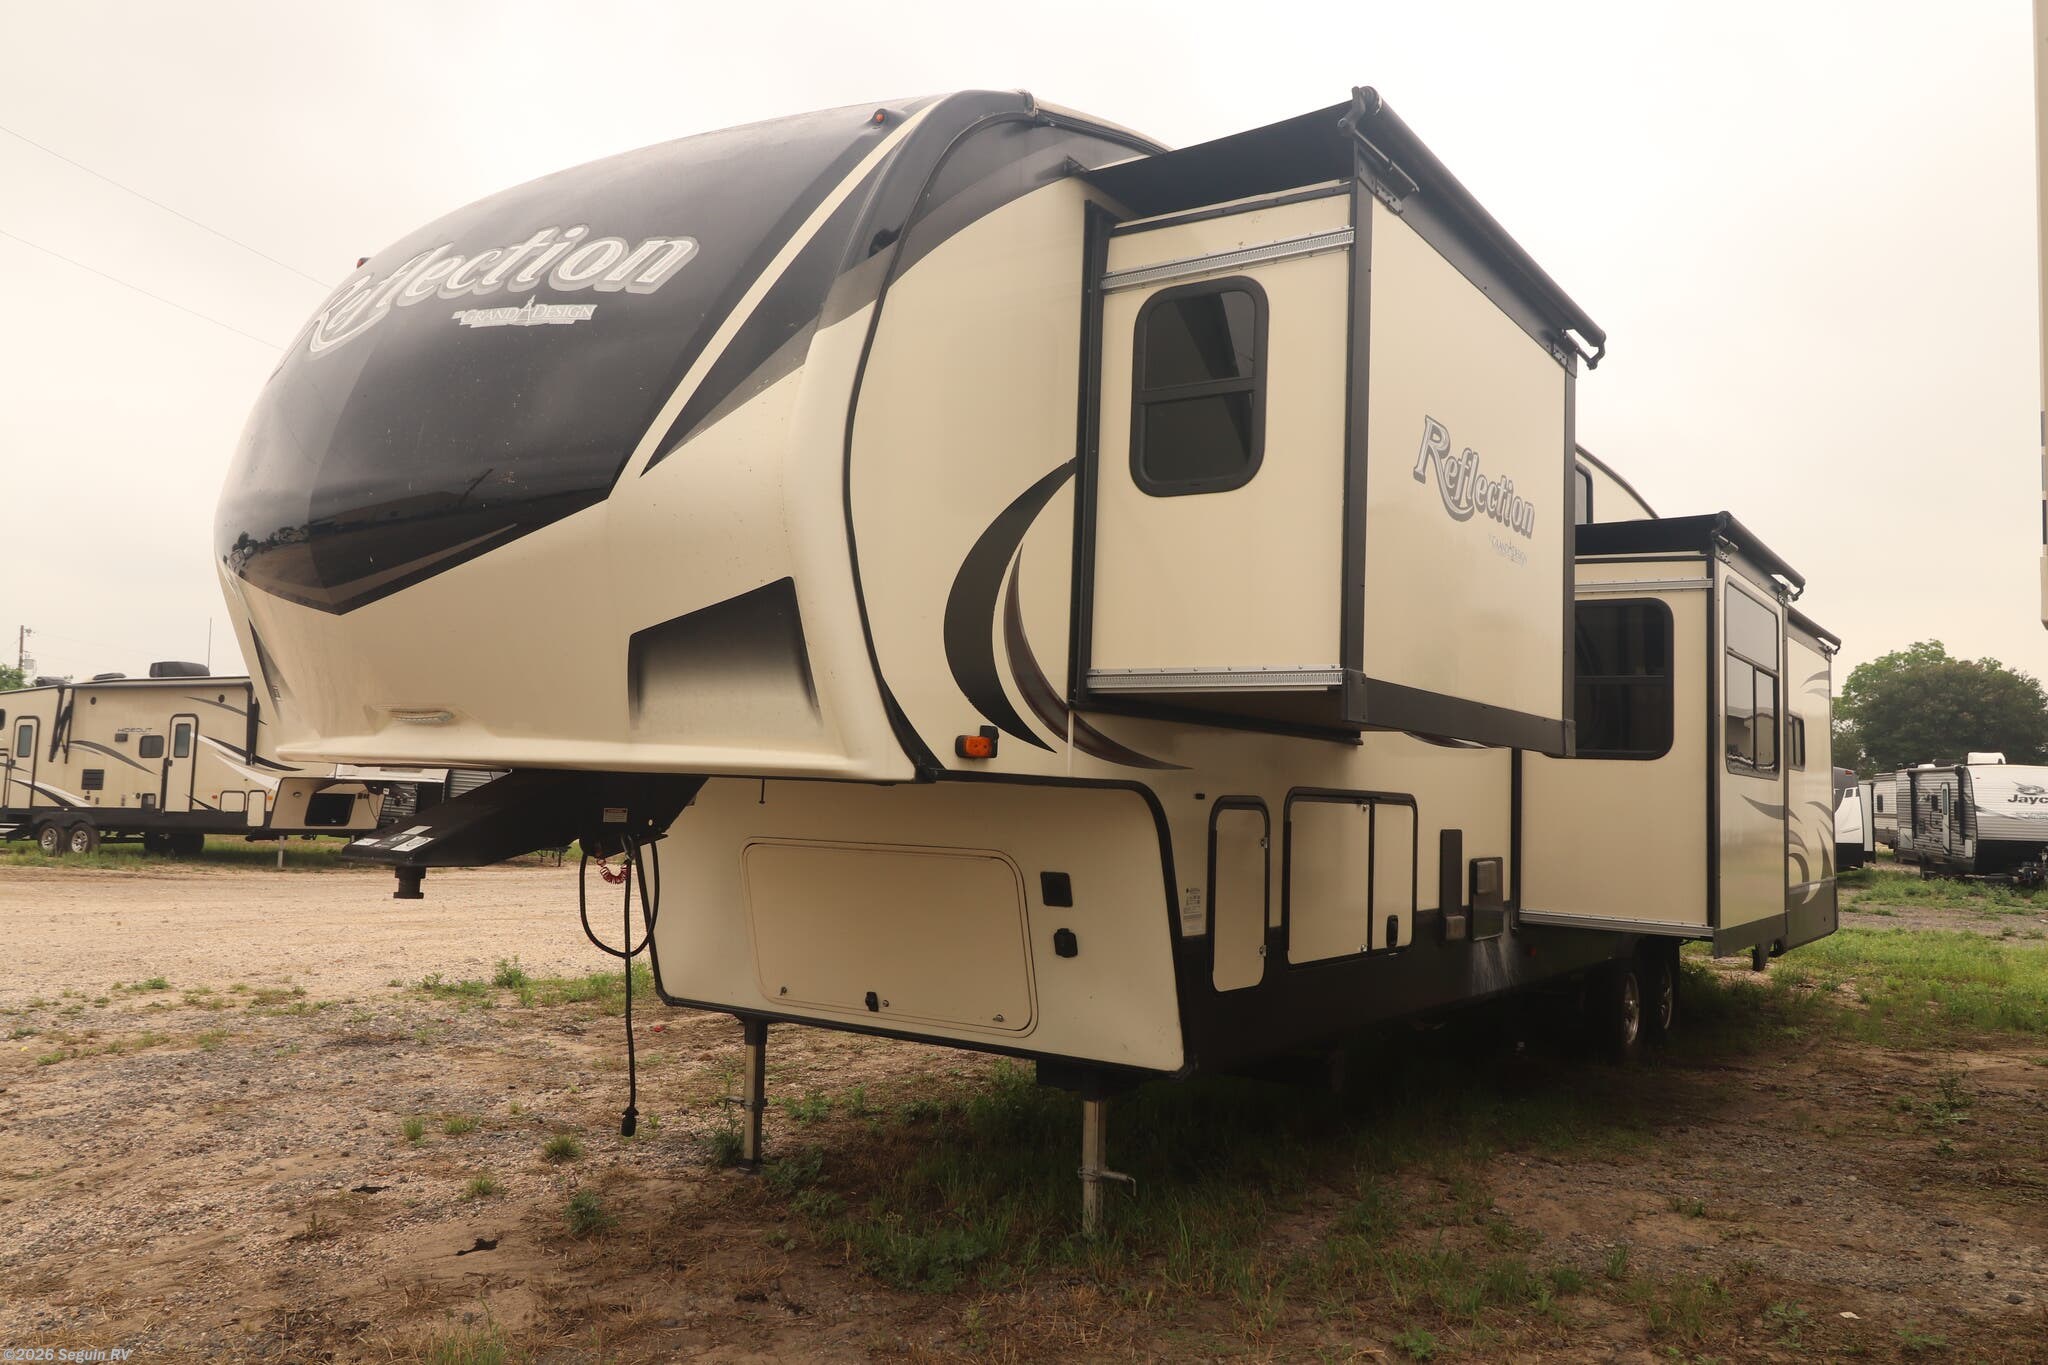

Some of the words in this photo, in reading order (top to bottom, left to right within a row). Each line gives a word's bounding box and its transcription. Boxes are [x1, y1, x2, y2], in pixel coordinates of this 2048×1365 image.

[304, 224, 700, 360] Reflection
[462, 307, 520, 323] GRAND
[531, 304, 598, 320] DESIGN
[1413, 414, 1536, 540] Reflection
